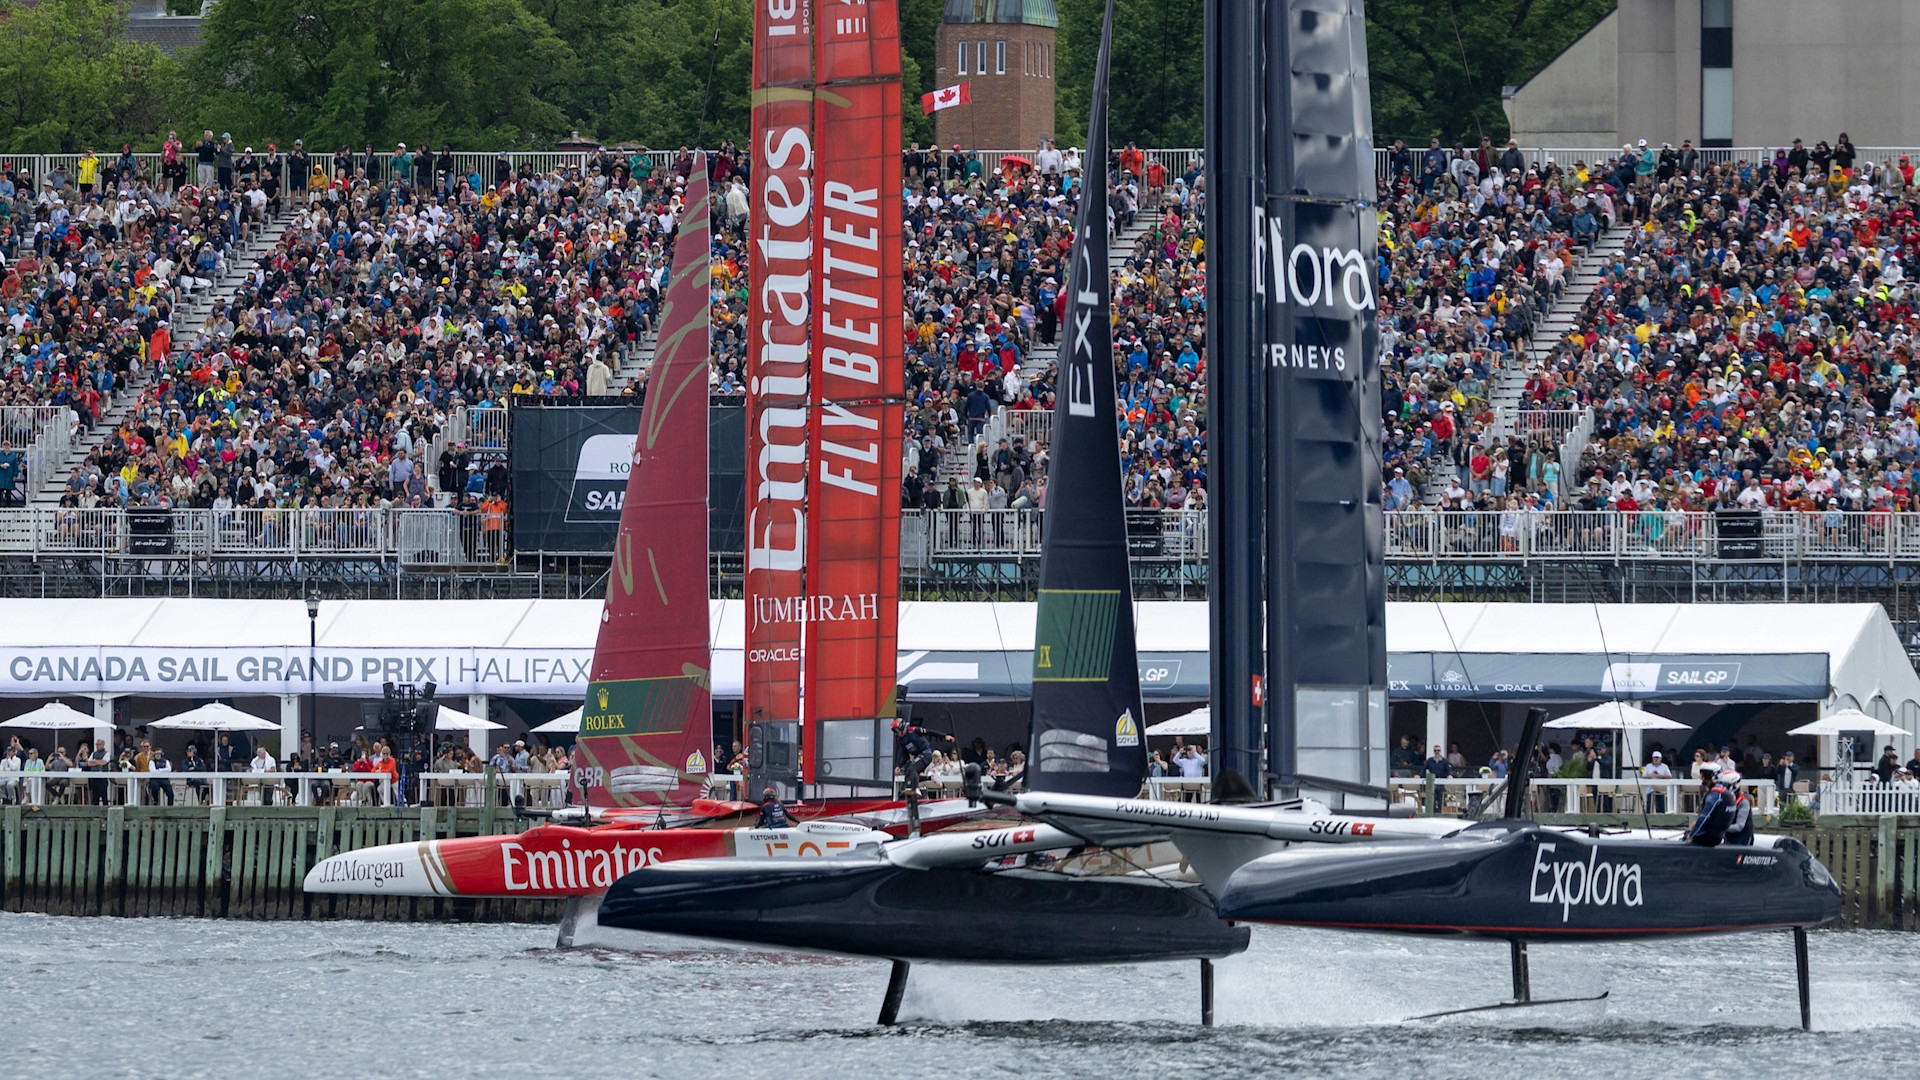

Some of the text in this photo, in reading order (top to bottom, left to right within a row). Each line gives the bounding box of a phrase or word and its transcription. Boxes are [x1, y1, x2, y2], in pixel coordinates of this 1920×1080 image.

[820, 180, 878, 496] FLY BETTER
[749, 127, 811, 574] Emirates
[752, 594, 878, 633] JUMEIRAH
[749, 648, 799, 662] ORACLE
[9, 656, 437, 682] CANADA SAIL GRAND PRIX
[459, 658, 590, 683] HALIFAX
[1495, 684, 1544, 692] ORACLE
[586, 714, 624, 730] ROLEX
[574, 766, 604, 788] GBR
[1116, 802, 1176, 817] POWERED
[1309, 820, 1349, 835] SUI
[972, 832, 1009, 849] SUI
[1529, 843, 1643, 922] Explora
